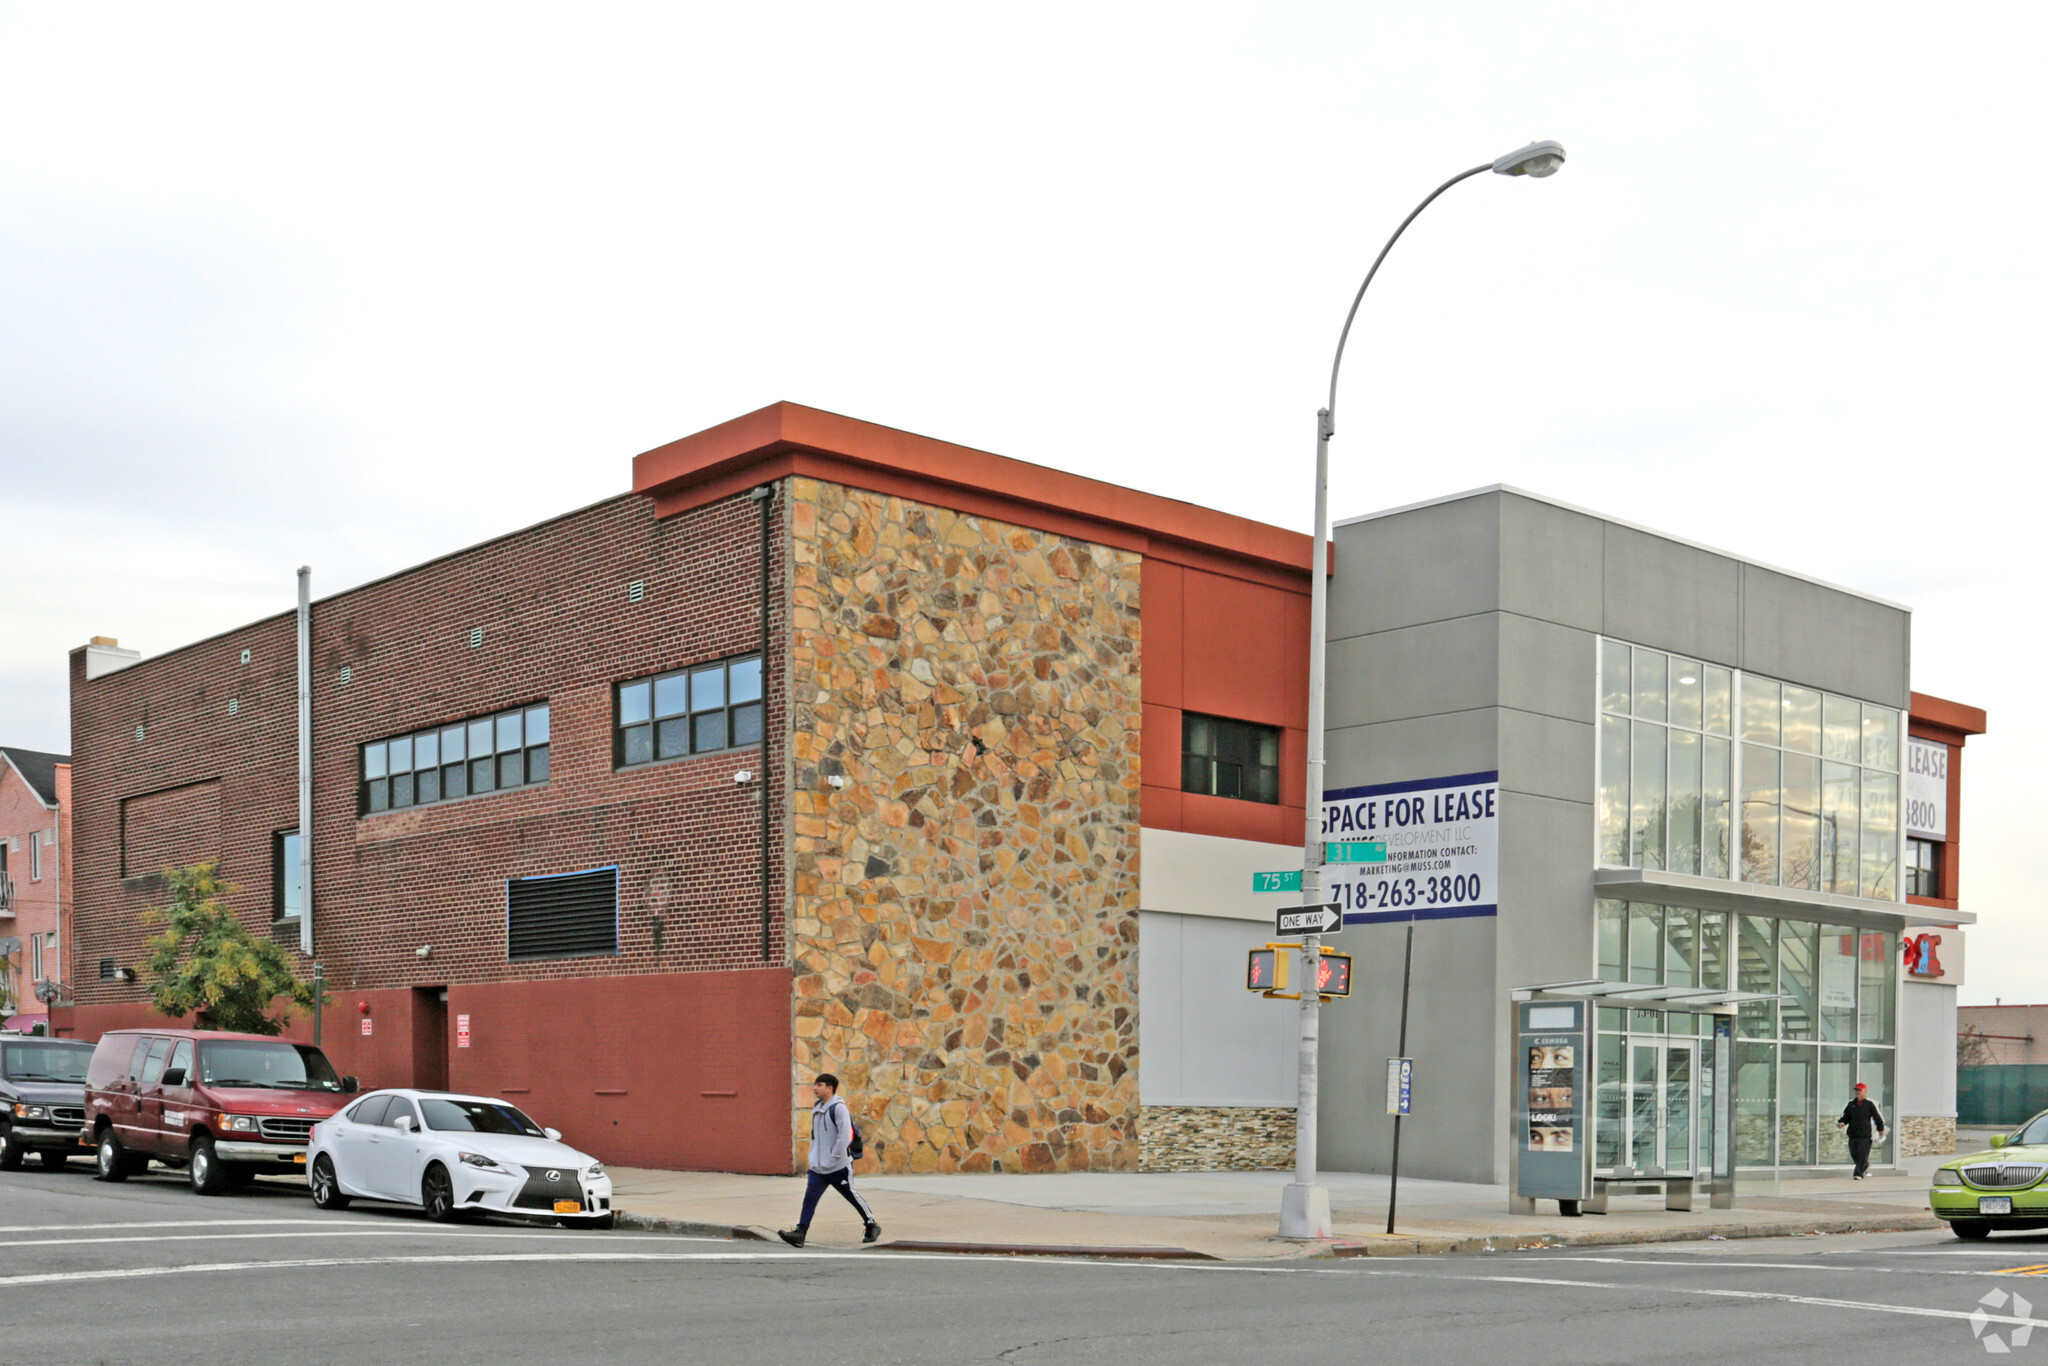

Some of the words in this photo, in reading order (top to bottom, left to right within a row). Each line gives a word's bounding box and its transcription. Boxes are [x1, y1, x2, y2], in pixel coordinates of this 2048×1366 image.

[1908, 744, 1945, 780] LEASE
[1385, 797, 1425, 828] FOR
[1434, 789, 1495, 823] LEASE
[1455, 826, 1472, 841] LLC
[1334, 844, 1352, 861] 31
[1388, 848, 1438, 861] NFORMATION
[1440, 845, 1478, 857] CONTACT:
[1359, 860, 1451, 876] MARKETING@MUSS.COM
[1261, 873, 1281, 890] 75
[1284, 873, 1294, 881] ST
[1331, 873, 1481, 909] 718-263-3800
[1283, 915, 1301, 927] ONE
[1305, 913, 1324, 926] WAY
